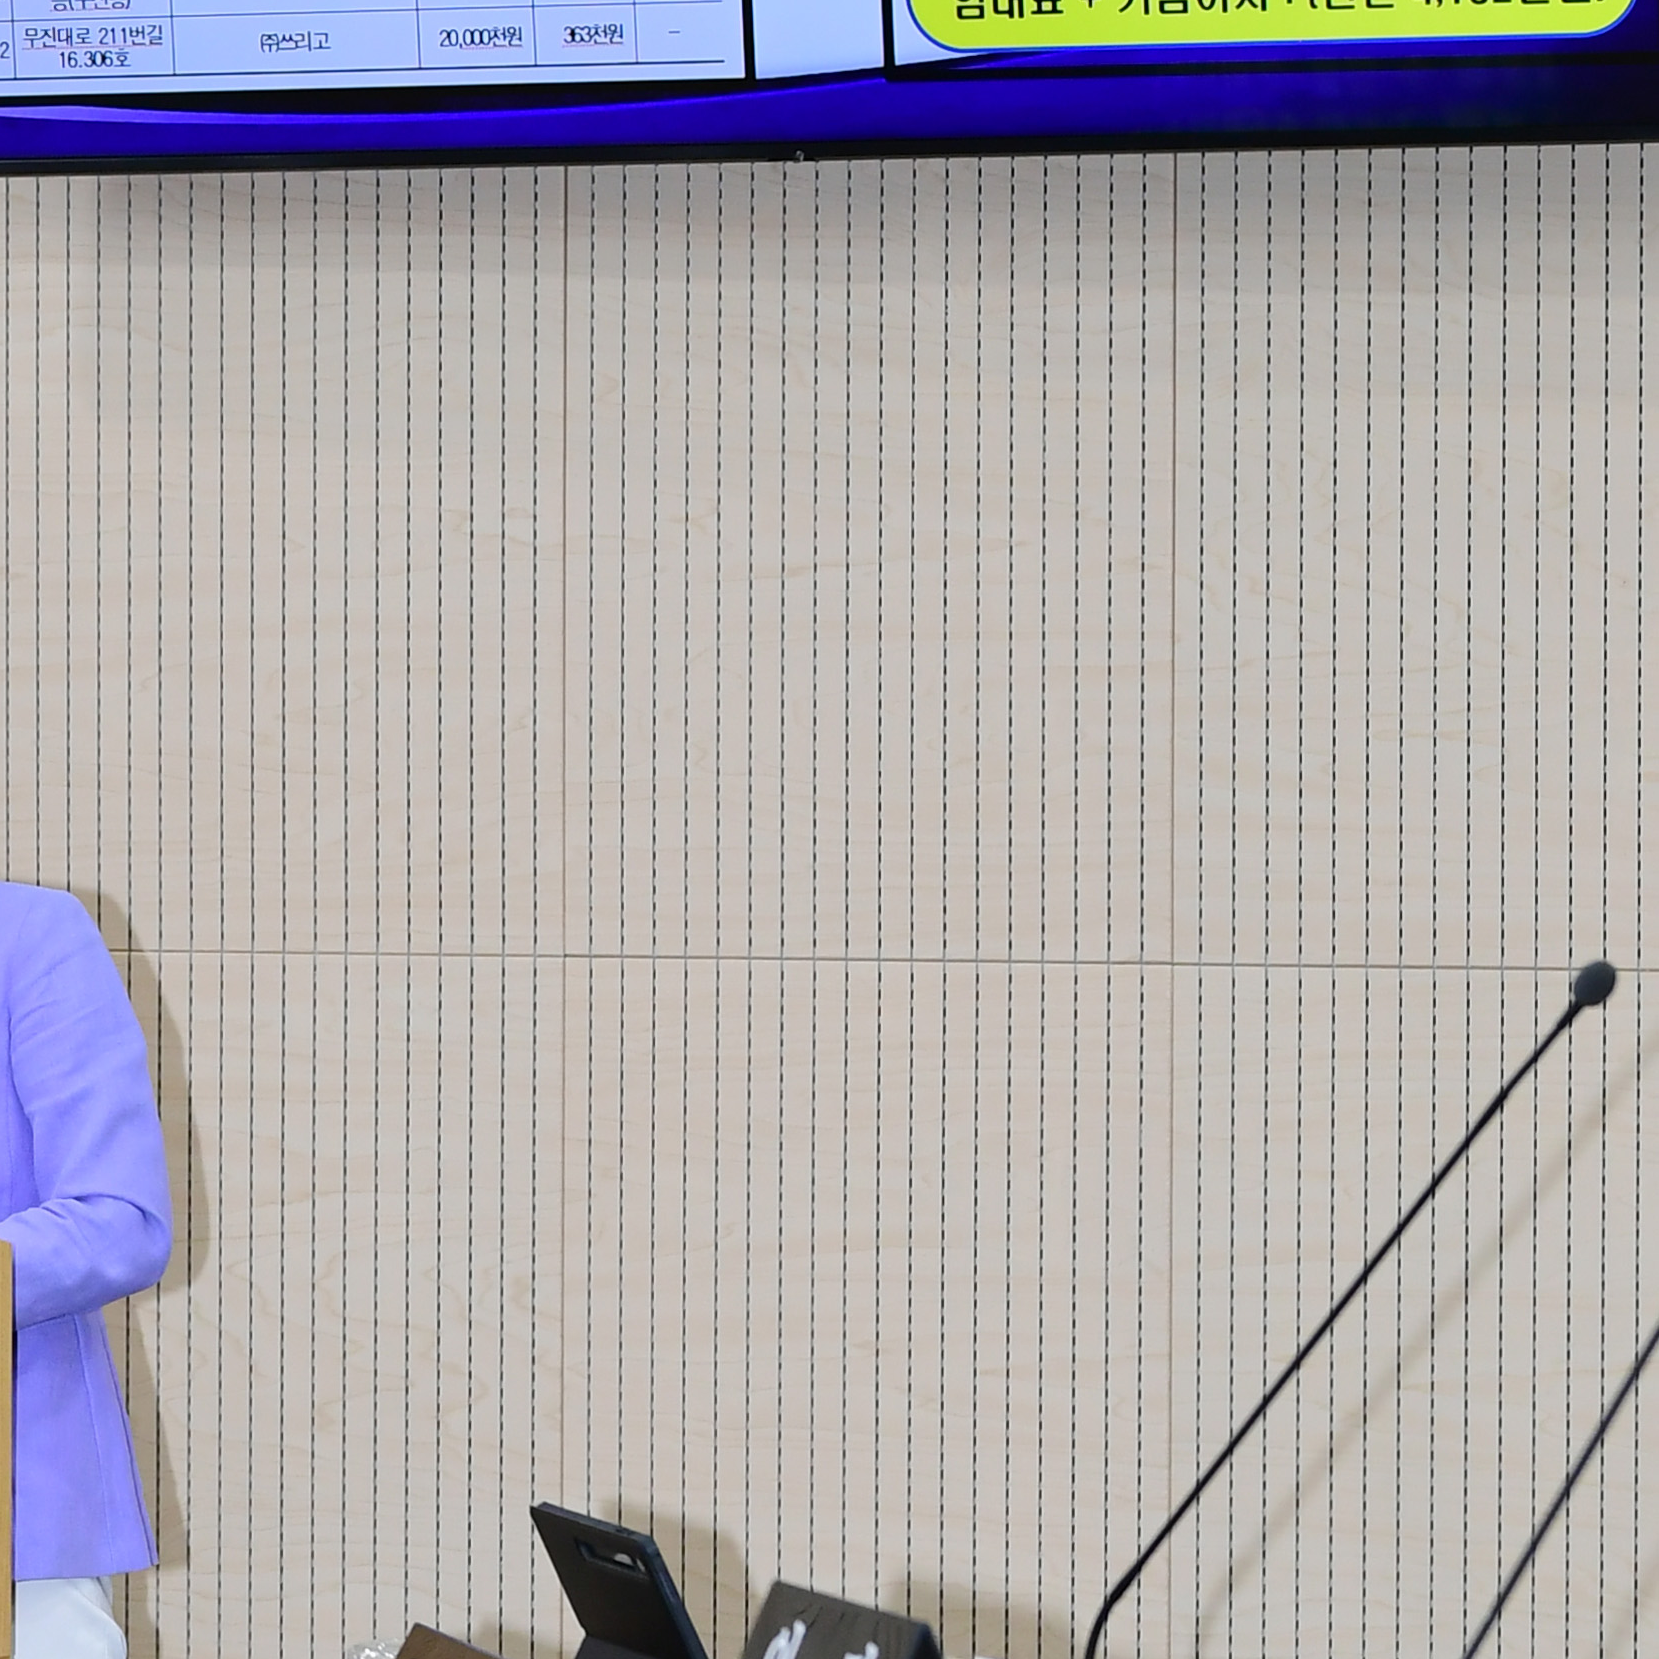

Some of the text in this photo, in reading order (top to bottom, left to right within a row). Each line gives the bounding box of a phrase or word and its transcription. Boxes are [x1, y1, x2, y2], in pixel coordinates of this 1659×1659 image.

[23, 26, 92, 49] 무진대로
[98, 25, 163, 46] 211번길
[440, 26, 523, 49] 20,000천원
[563, 22, 624, 46] 363천원
[59, 48, 131, 69] 16.306호
